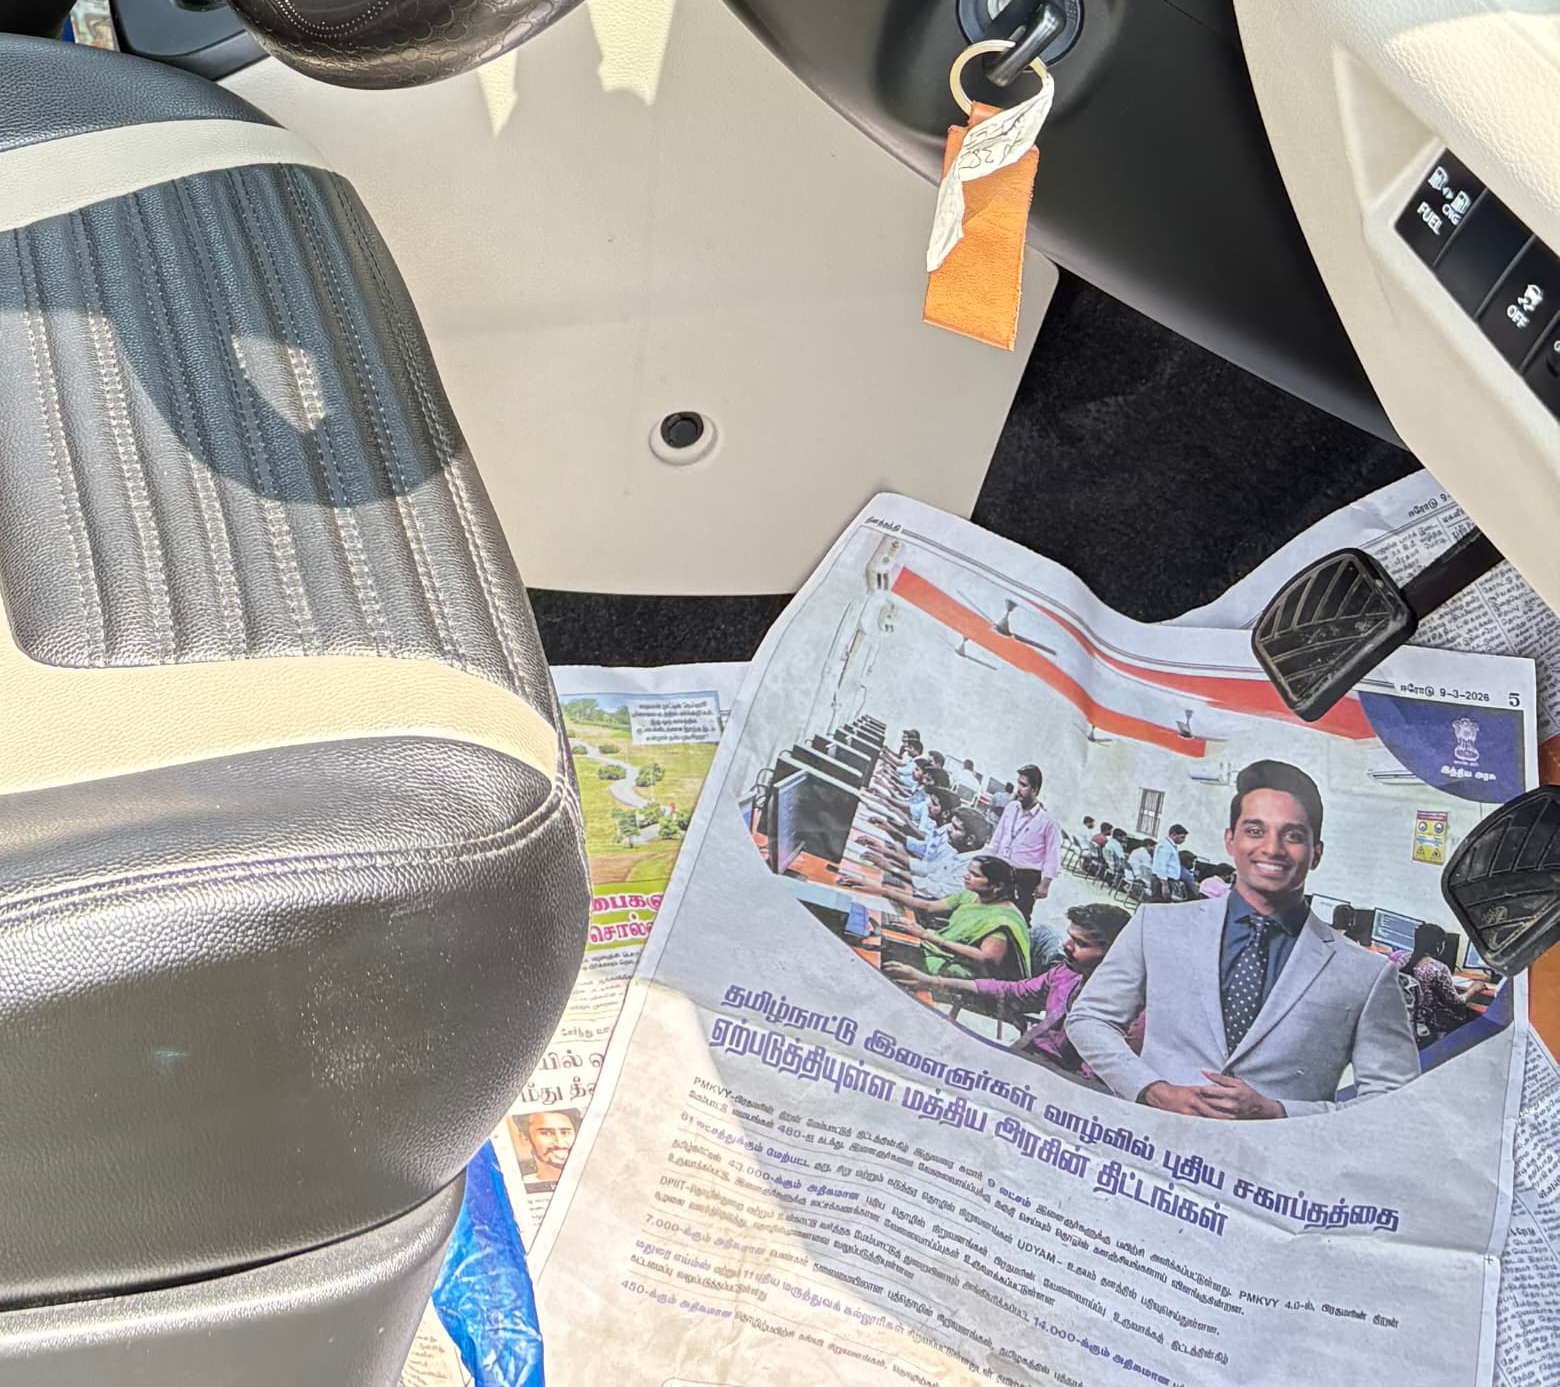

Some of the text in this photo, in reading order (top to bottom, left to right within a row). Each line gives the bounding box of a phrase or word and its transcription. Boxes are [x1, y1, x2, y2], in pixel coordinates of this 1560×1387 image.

[1417, 201, 1443, 236] FUEL
[1507, 305, 1530, 328] OFF
[1400, 683, 1490, 702] ஈரோடு 9-3-2026
[1508, 693, 1521, 707] 5
[721, 984, 1399, 1232] தமிழ்நாட்டு இளைஞர்கள் வாழ்வில் புதிய சகாப்தத்தை
[709, 1018, 1228, 1237] ஏற்படுத்தியுள்ள மத்திய அரசின் திட்டங்கள்
[766, 1145, 810, 1169] மேற்பட்ட
[1016, 1239, 1056, 1264] UDYAM
[806, 1183, 859, 1202] அதிகமான
[636, 1238, 671, 1259] மதுரை
[987, 1177, 995, 1187] 9
[998, 1185, 1031, 1209] லட்சம்
[1239, 1289, 1278, 1308] PMKVY
[679, 1298, 732, 1320] அதிகமான
[1112, 1353, 1169, 1386] அதிகமான
